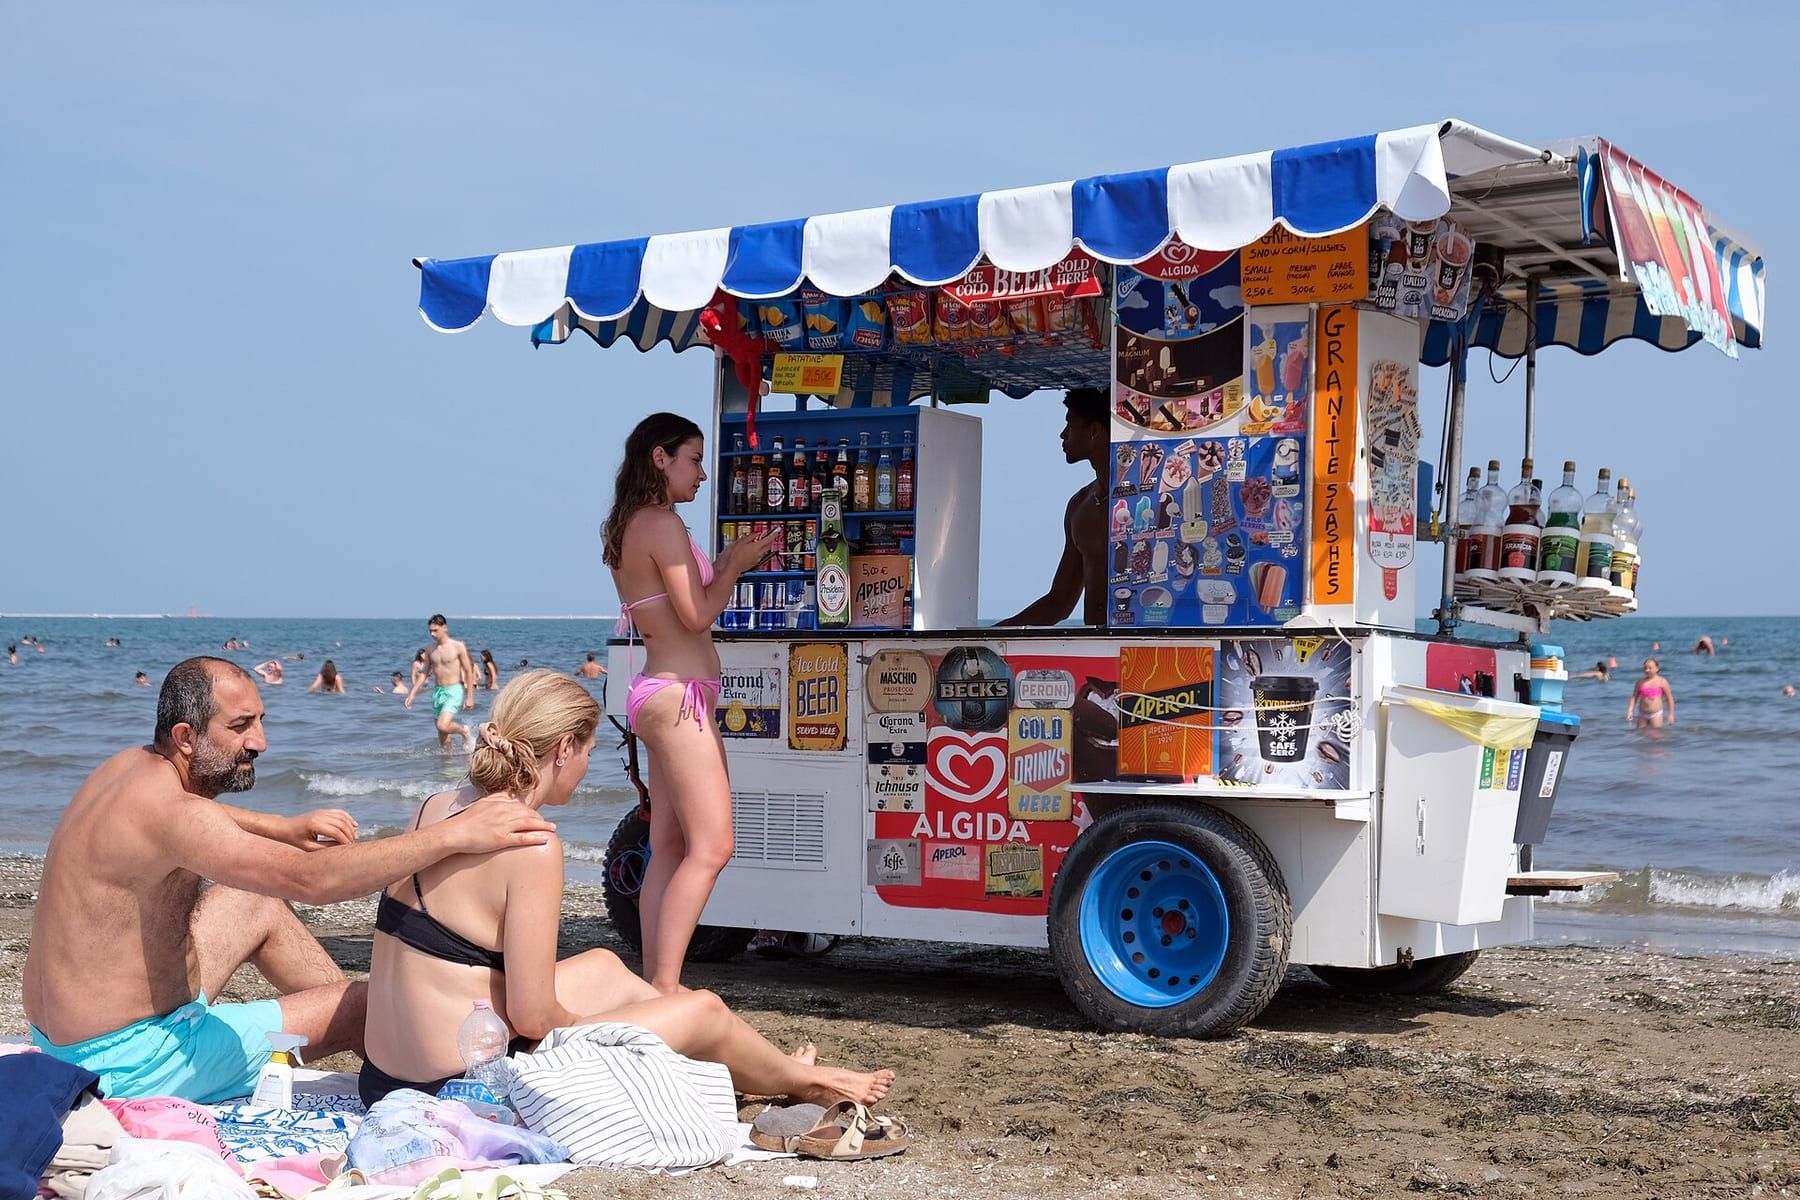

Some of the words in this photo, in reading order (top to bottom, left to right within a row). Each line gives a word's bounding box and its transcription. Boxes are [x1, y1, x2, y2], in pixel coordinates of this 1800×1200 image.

[1057, 258, 1091, 274] SOLD
[1160, 264, 1198, 277] ALGIDA
[1245, 265, 1274, 276] SMALL
[1289, 264, 1317, 273] MEDIUM
[1329, 261, 1353, 271] LARGE
[963, 271, 984, 285] ICE
[992, 266, 1054, 298] BEER
[1056, 271, 1089, 286] HERE
[1404, 275, 1426, 287] ESPRESSO
[955, 283, 989, 298] COLD
[1118, 349, 1150, 359] MAGNUM
[1324, 308, 1345, 475] GRANITE
[1505, 543, 1532, 551] ARANCIA
[881, 565, 888, 575] €
[1110, 575, 1129, 584] CLASSIC
[856, 575, 904, 603] APEROL
[865, 593, 897, 609] SPRITZ
[881, 605, 888, 615] €
[797, 656, 812, 673] Ice
[815, 656, 840, 673] Cold
[719, 672, 765, 690] orona
[880, 672, 917, 685] MASCHIO
[724, 689, 747, 699] Extra
[940, 680, 1009, 698] BECK'S
[1022, 683, 1067, 697] PERONI
[796, 675, 839, 719] BEER
[1131, 690, 1198, 722] APEROL
[879, 715, 915, 729] Corona
[1018, 714, 1063, 741] COLD
[796, 726, 819, 736] SERVED
[819, 726, 836, 736] HERE
[889, 726, 908, 734] Extra
[1269, 739, 1296, 750] CAFÉ
[1270, 749, 1295, 757] ZERO
[1014, 747, 1066, 786] DRINKS
[875, 779, 919, 793] Ichnusa
[1018, 794, 1062, 814] HERE
[911, 811, 1031, 843] ALGIDA
[883, 852, 904, 871] Leffe
[932, 846, 967, 863] APEROL
